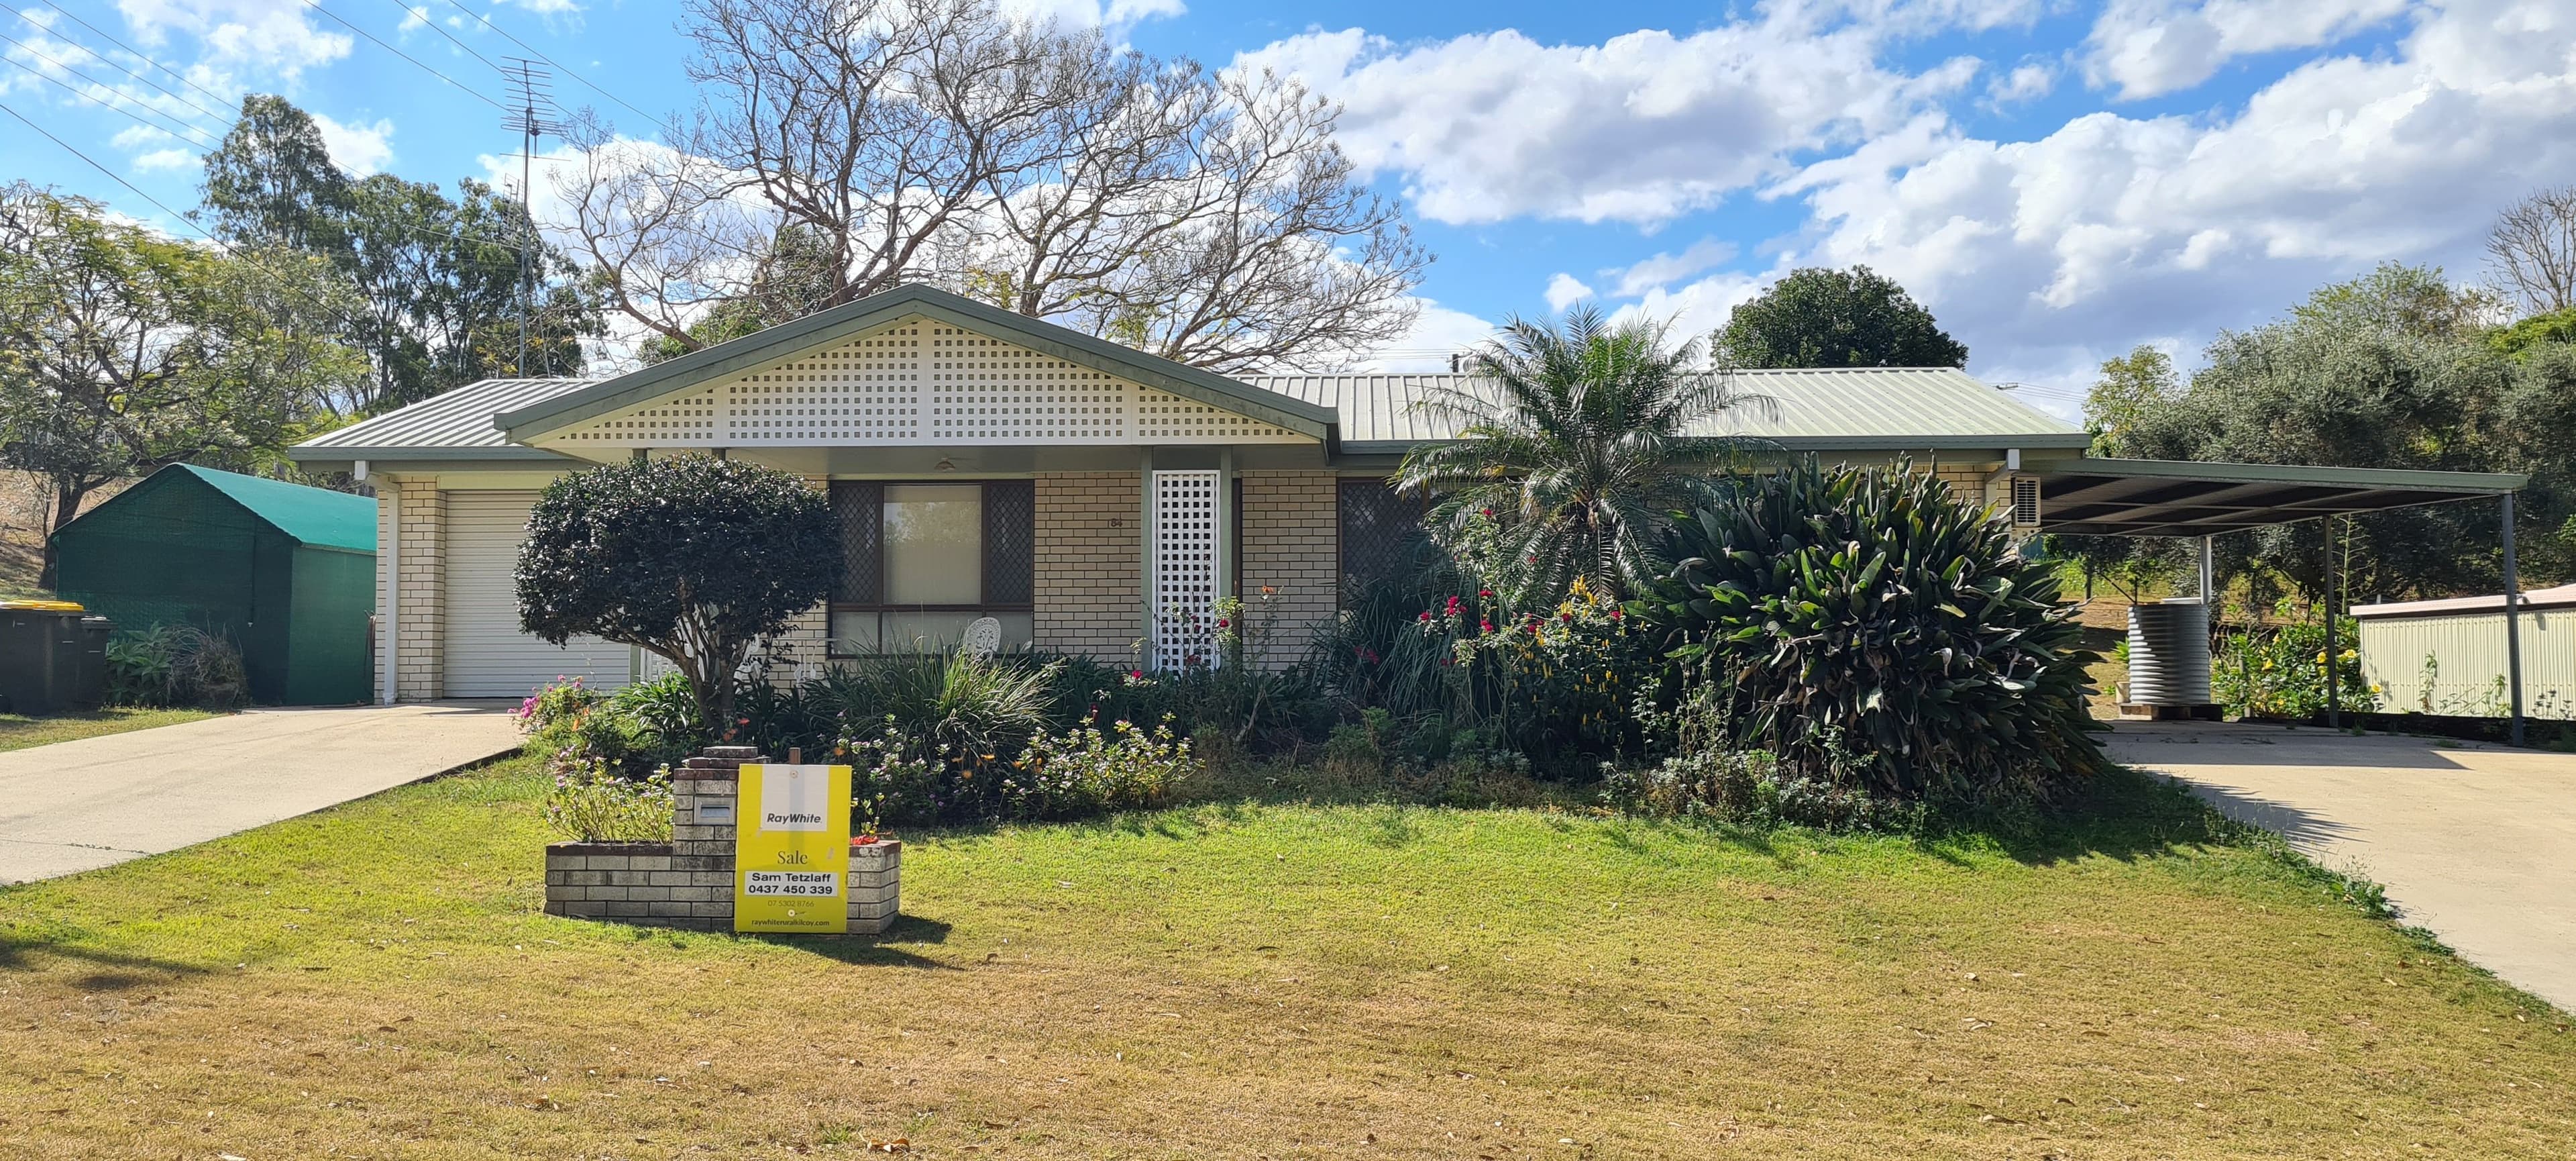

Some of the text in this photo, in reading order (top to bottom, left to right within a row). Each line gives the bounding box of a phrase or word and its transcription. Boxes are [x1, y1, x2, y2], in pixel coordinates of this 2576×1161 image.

[777, 850, 808, 864] Sale
[751, 872, 831, 882] Sam Tetzlaff
[749, 885, 833, 895] 0437 450 339
[751, 918, 830, 927] raywhiteruralkilcoy.com
